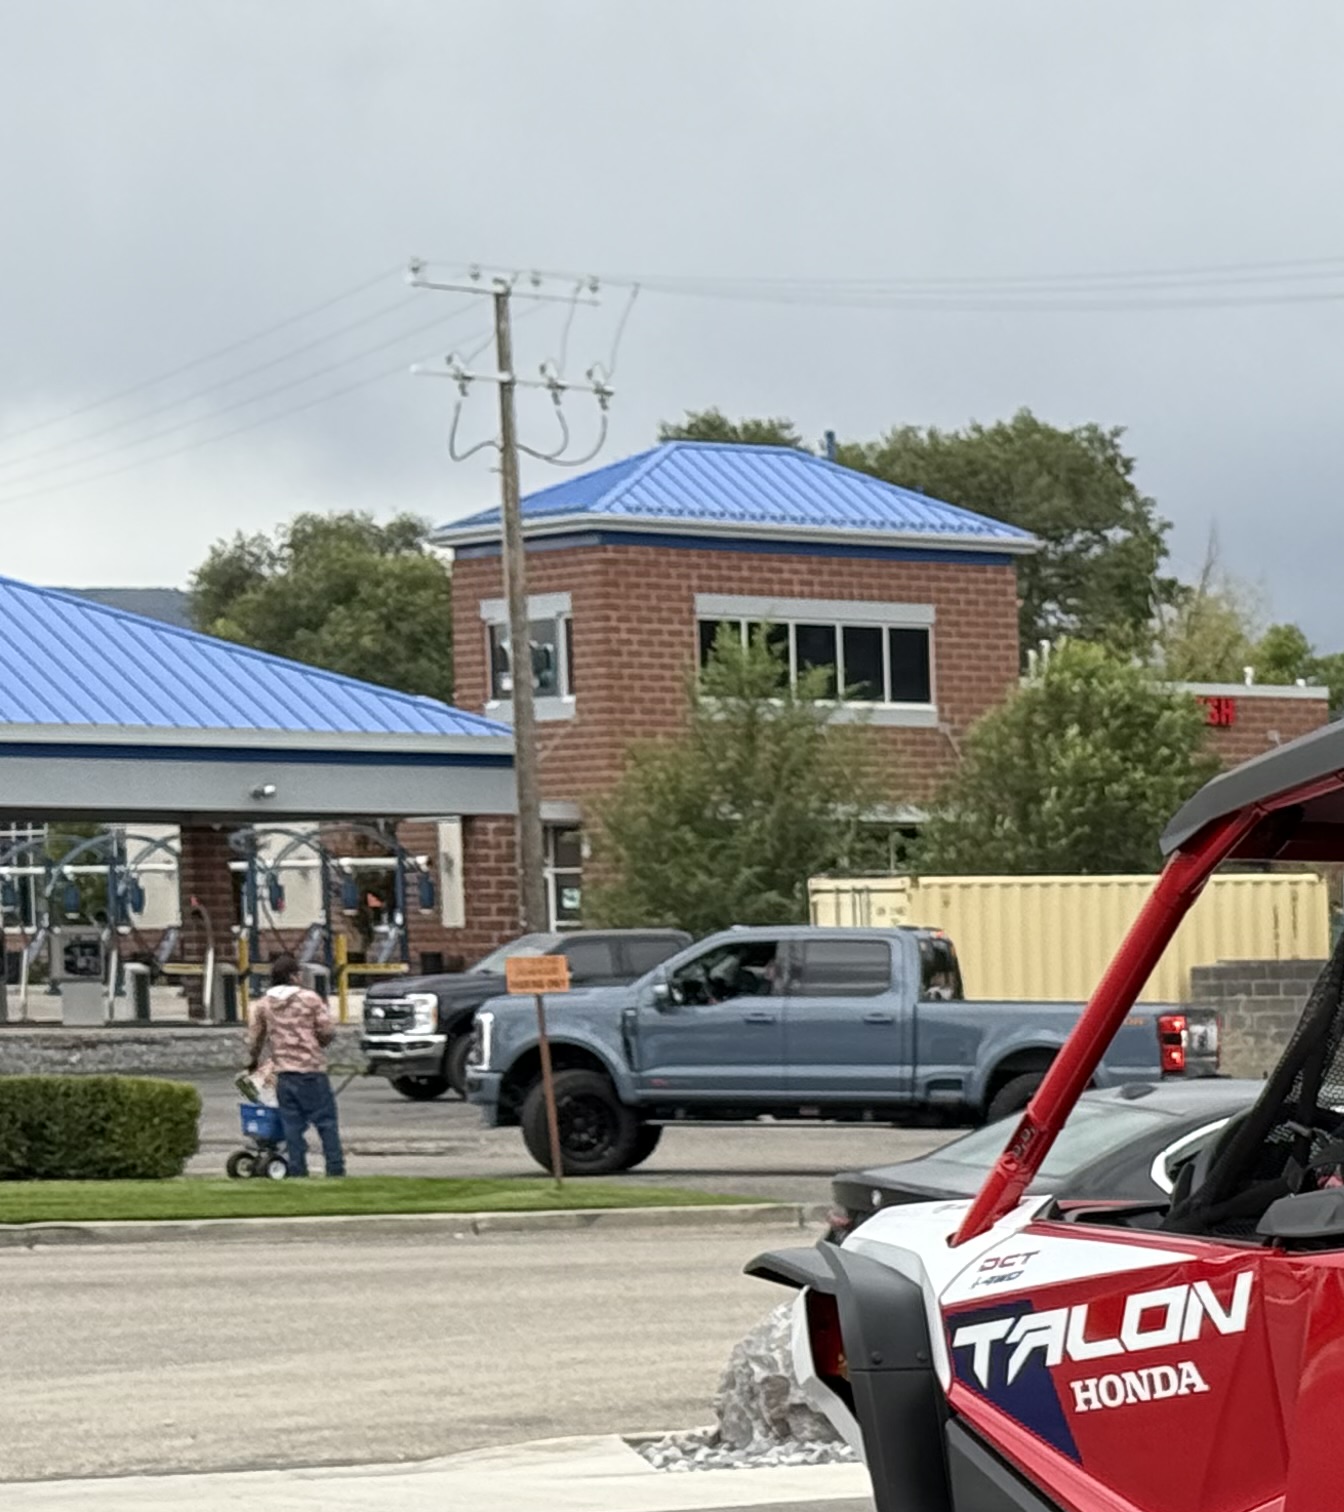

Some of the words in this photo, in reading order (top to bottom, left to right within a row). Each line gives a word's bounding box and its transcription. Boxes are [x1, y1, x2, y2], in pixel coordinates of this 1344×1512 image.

[977, 1249, 1041, 1273] DCT
[952, 1270, 1254, 1390] TALON
[1071, 1361, 1210, 1413] HONDA
